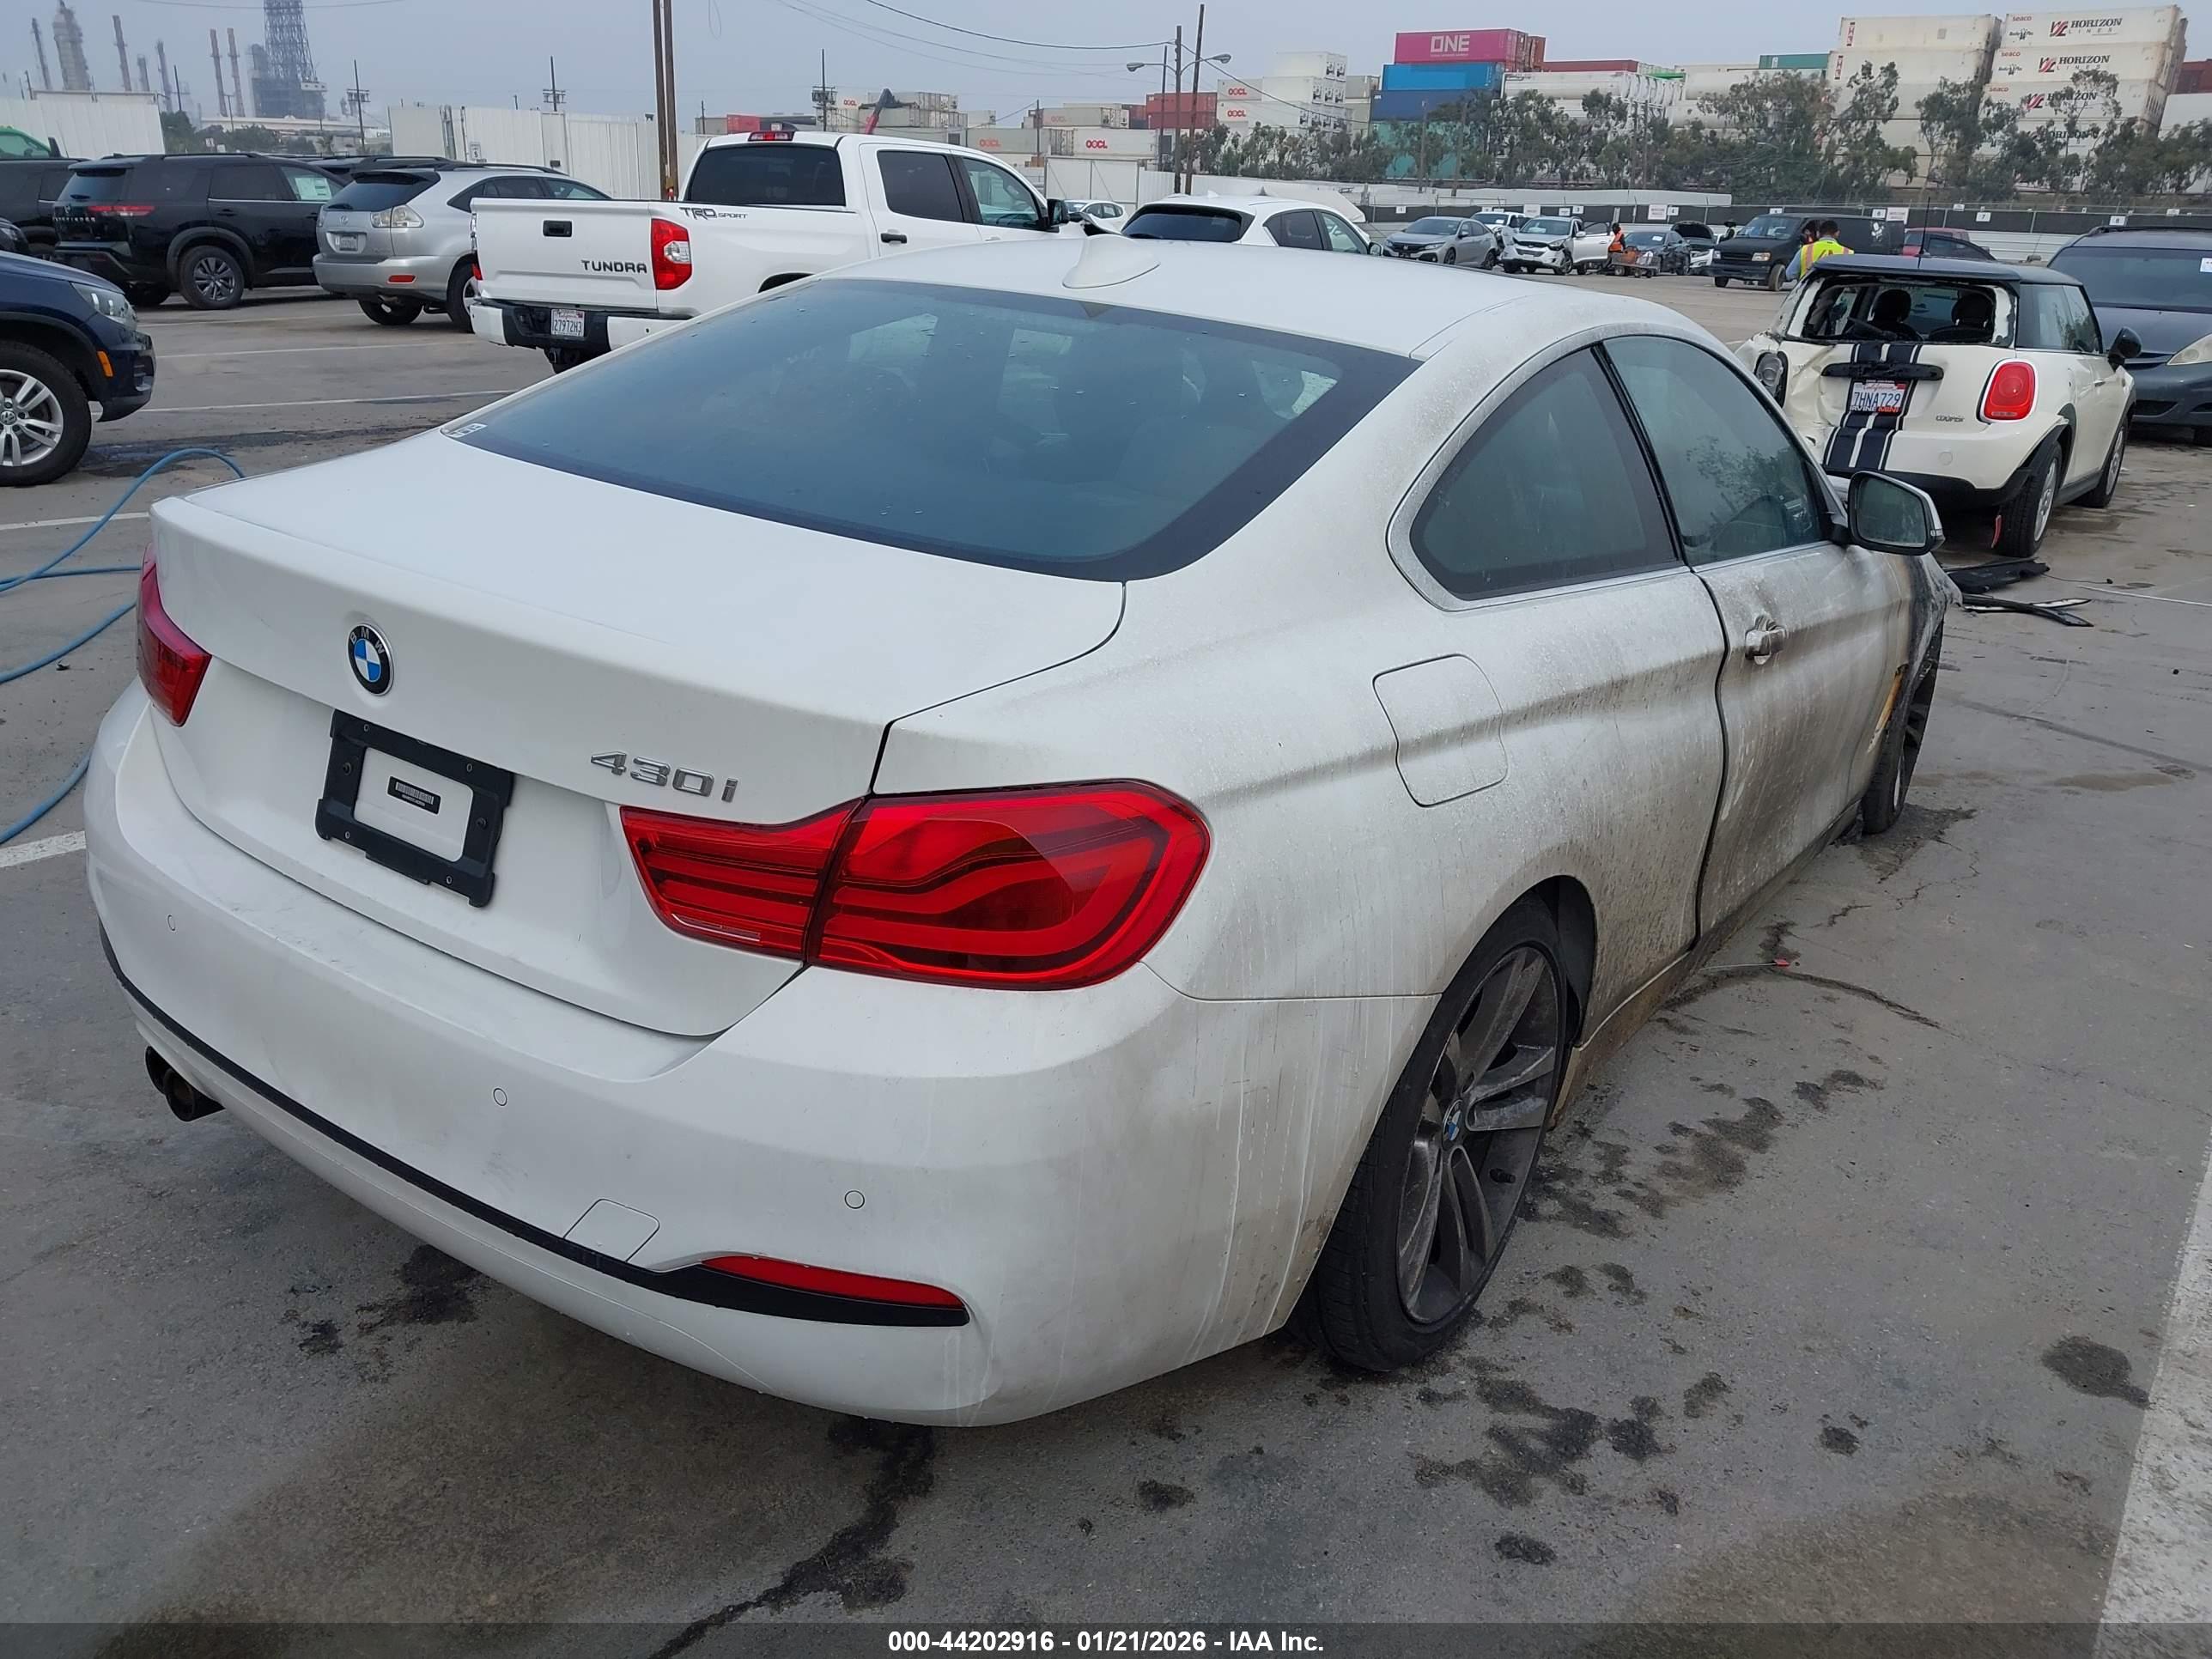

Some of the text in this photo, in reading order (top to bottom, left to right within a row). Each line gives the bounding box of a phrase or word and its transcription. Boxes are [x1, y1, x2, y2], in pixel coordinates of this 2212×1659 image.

[2070, 18, 2123, 28] HORIZON
[1430, 34, 1470, 52] ONE
[2058, 55, 2110, 64] HORIZON
[1085, 139, 1108, 149] OOCL
[678, 206, 718, 221] TRD
[580, 259, 648, 274] TUNDRA
[554, 319, 582, 333] 27972H3
[1854, 392, 1901, 408] 7HNA729
[349, 626, 386, 654] BMW
[591, 751, 738, 803] 430i
